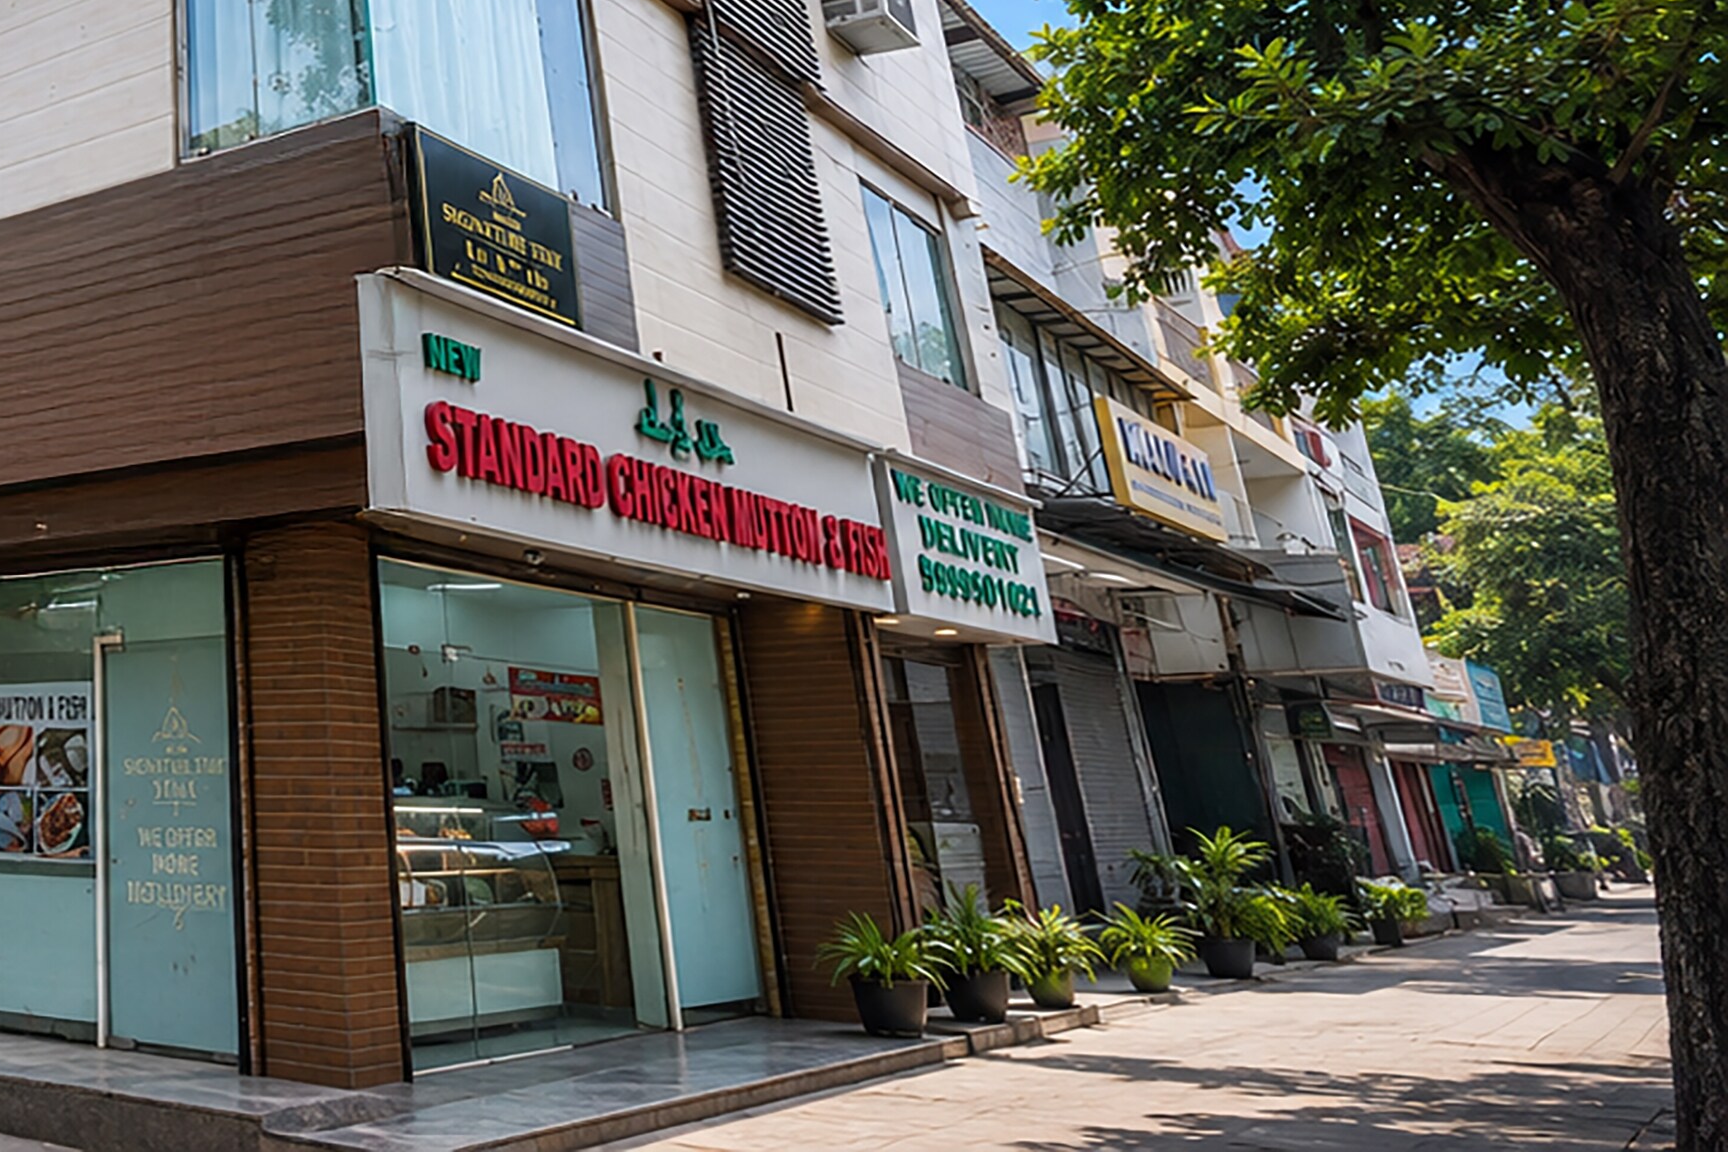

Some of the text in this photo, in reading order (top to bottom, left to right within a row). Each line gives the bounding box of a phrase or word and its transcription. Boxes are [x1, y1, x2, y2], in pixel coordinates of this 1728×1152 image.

[422, 332, 481, 383] NEW
[424, 400, 605, 510] STANDARD
[607, 453, 730, 543] CHICKEN
[724, 486, 822, 565] MUTTON
[839, 519, 892, 581] FISH
